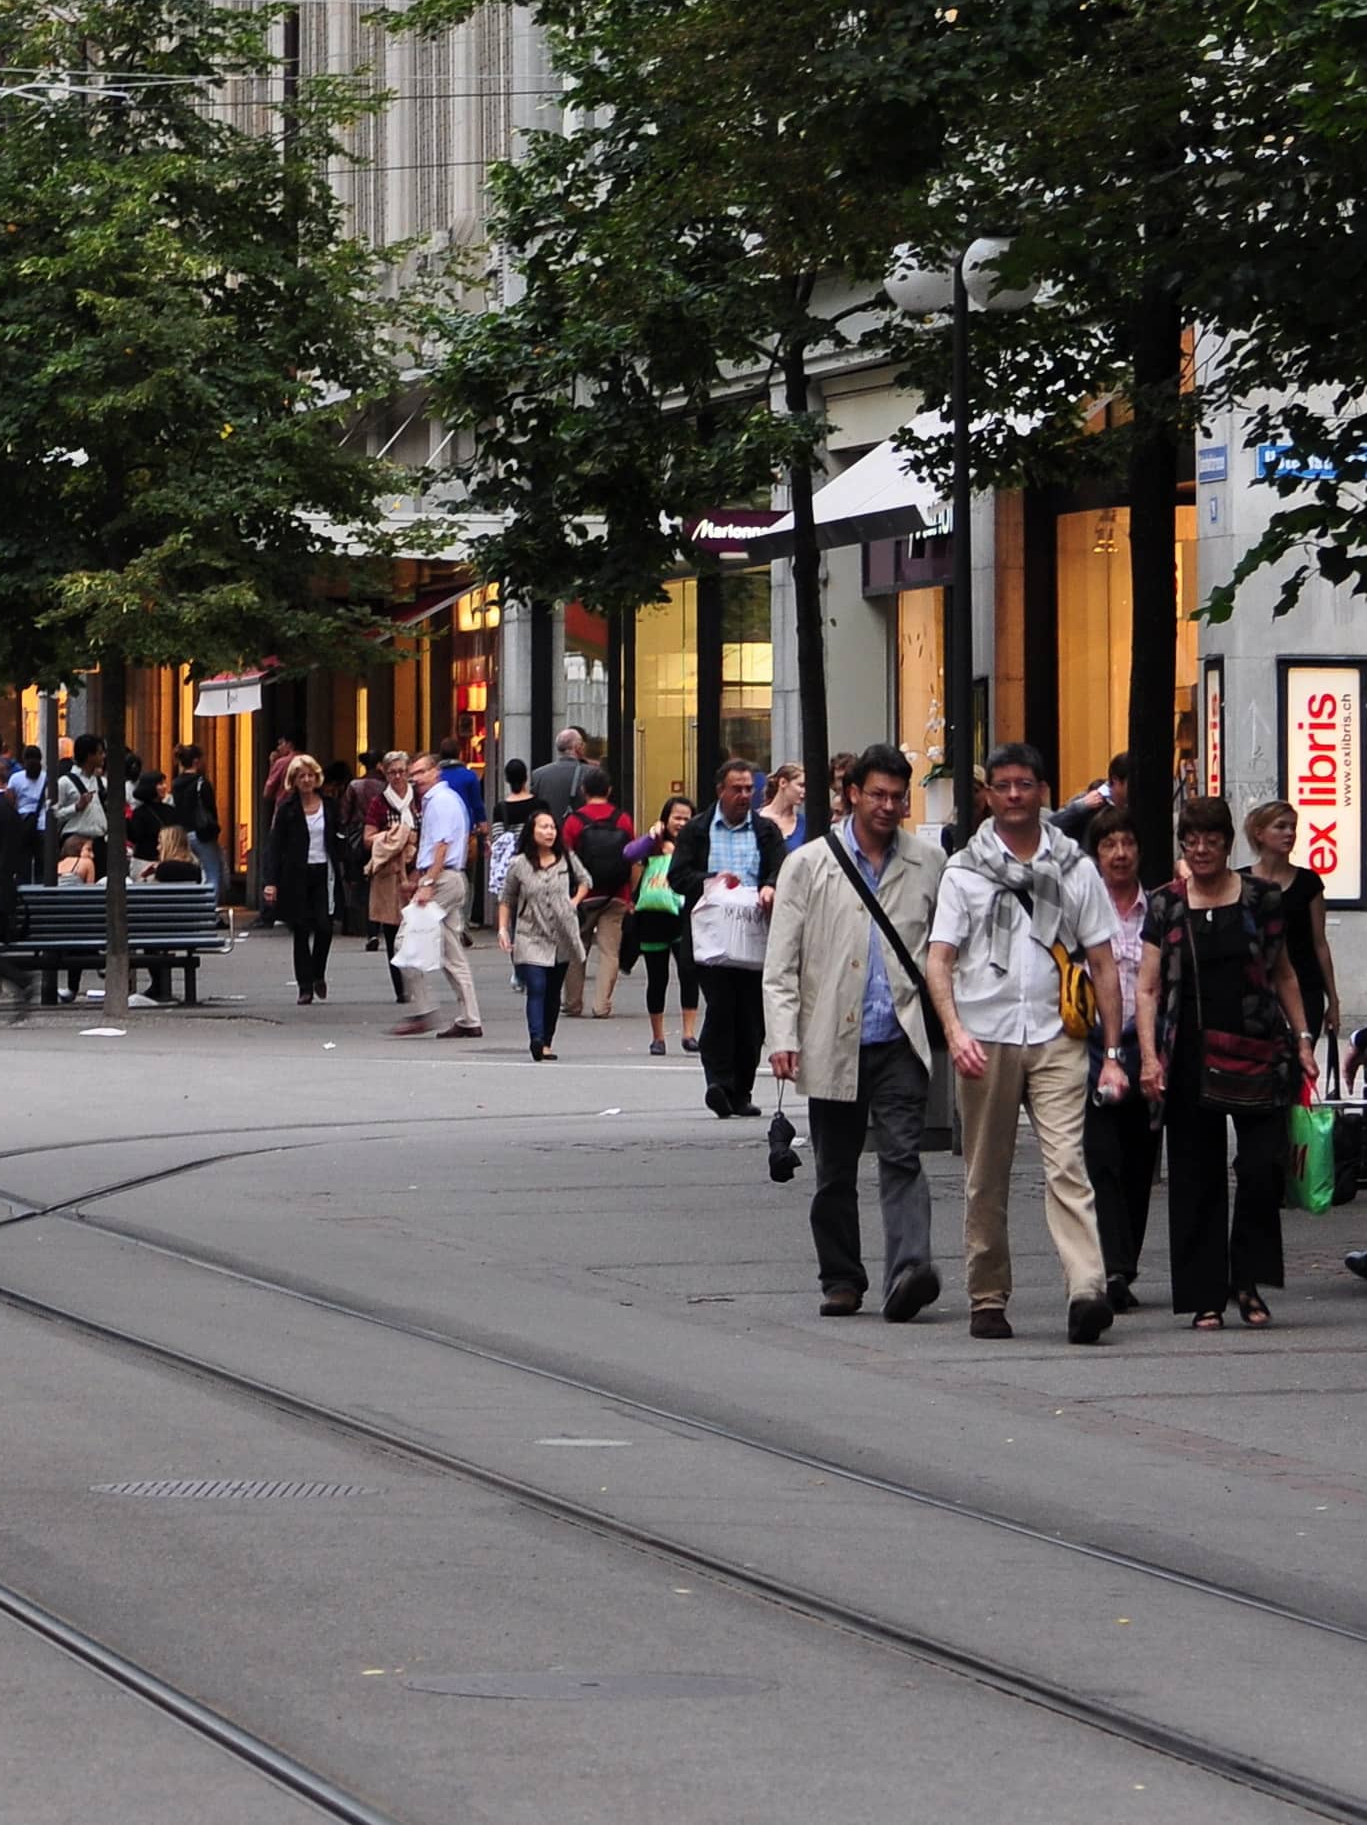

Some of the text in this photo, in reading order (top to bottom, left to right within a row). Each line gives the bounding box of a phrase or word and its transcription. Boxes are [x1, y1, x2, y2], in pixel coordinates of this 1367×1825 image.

[1298, 693, 1338, 875] ex libris
[1341, 693, 1352, 807] www.exlibris.ch
